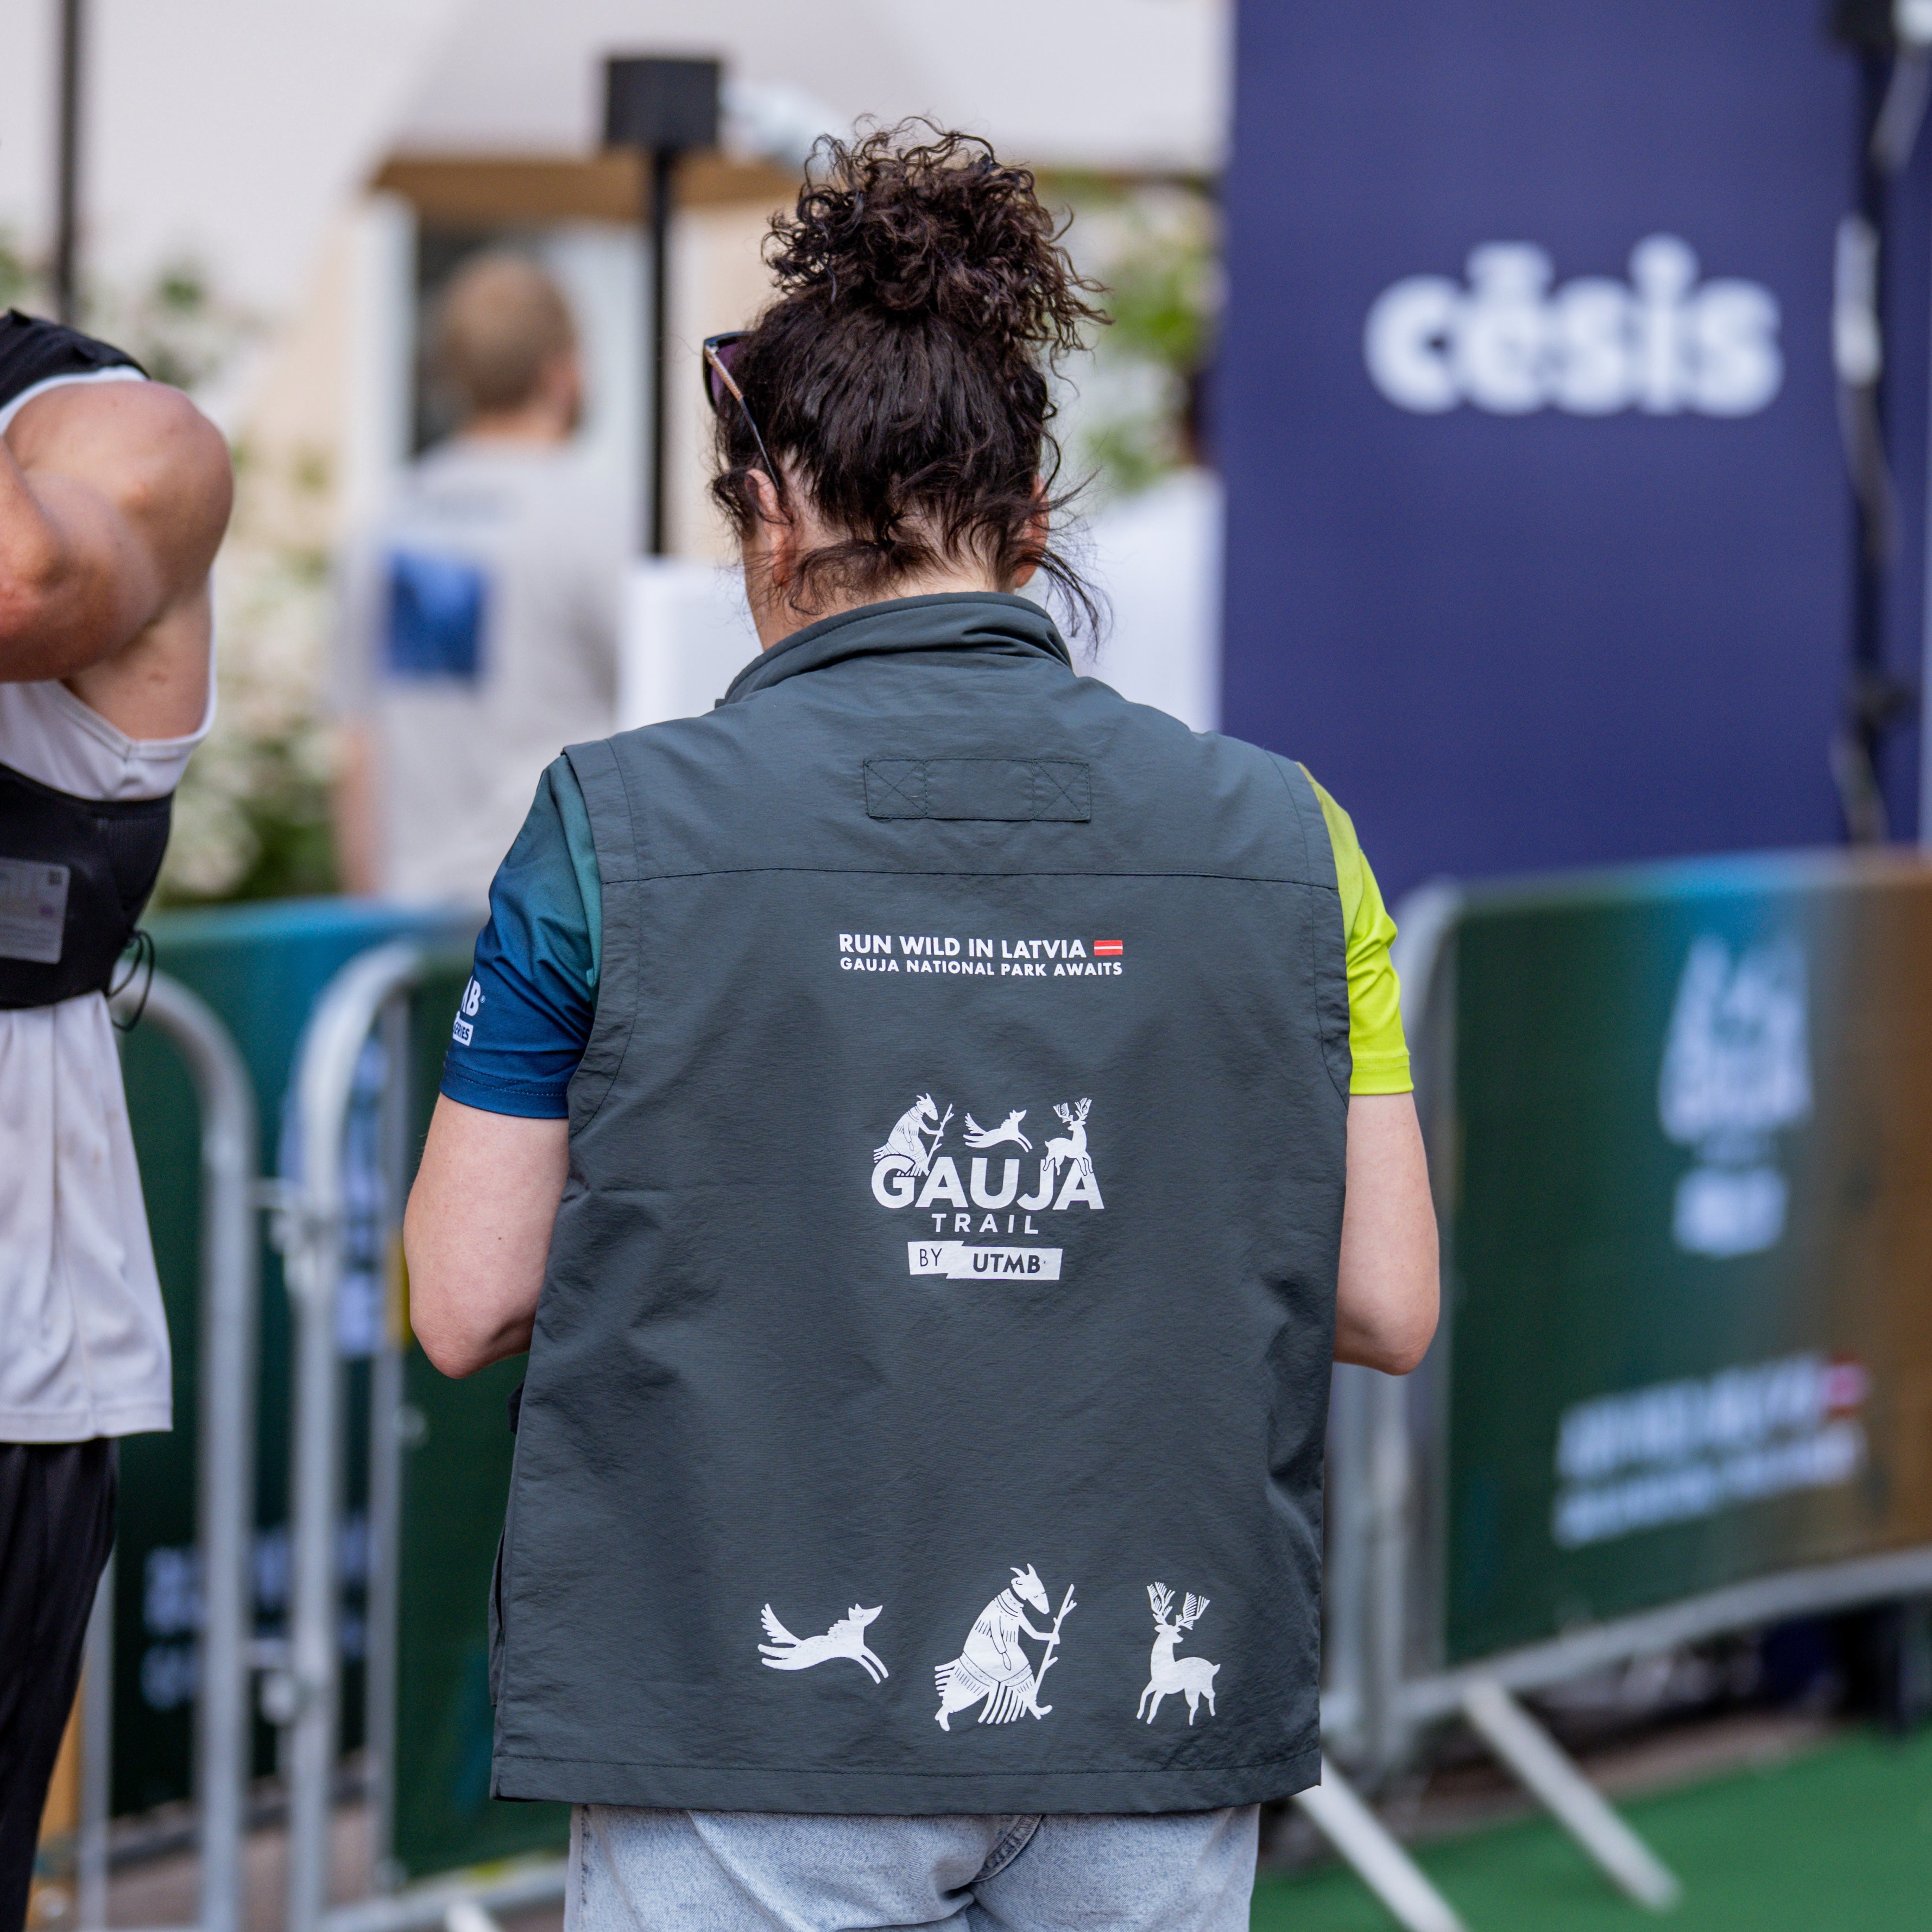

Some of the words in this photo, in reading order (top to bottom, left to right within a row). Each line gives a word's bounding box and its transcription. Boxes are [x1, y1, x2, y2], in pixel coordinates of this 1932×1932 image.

[839, 933, 892, 954] RUN
[899, 936, 961, 956] WILD
[968, 938, 993, 958] IN
[1001, 939, 1087, 959] LATVIA
[840, 957, 900, 972] GAUJA
[906, 959, 995, 975] NATIONAL
[1001, 963, 1047, 976] PARK
[1053, 962, 1122, 976] AWAITS
[871, 1154, 1105, 1211] GAUJA
[931, 1213, 1039, 1234] TRAIL
[919, 1248, 942, 1267] BY
[973, 1253, 1040, 1274] UTMB
